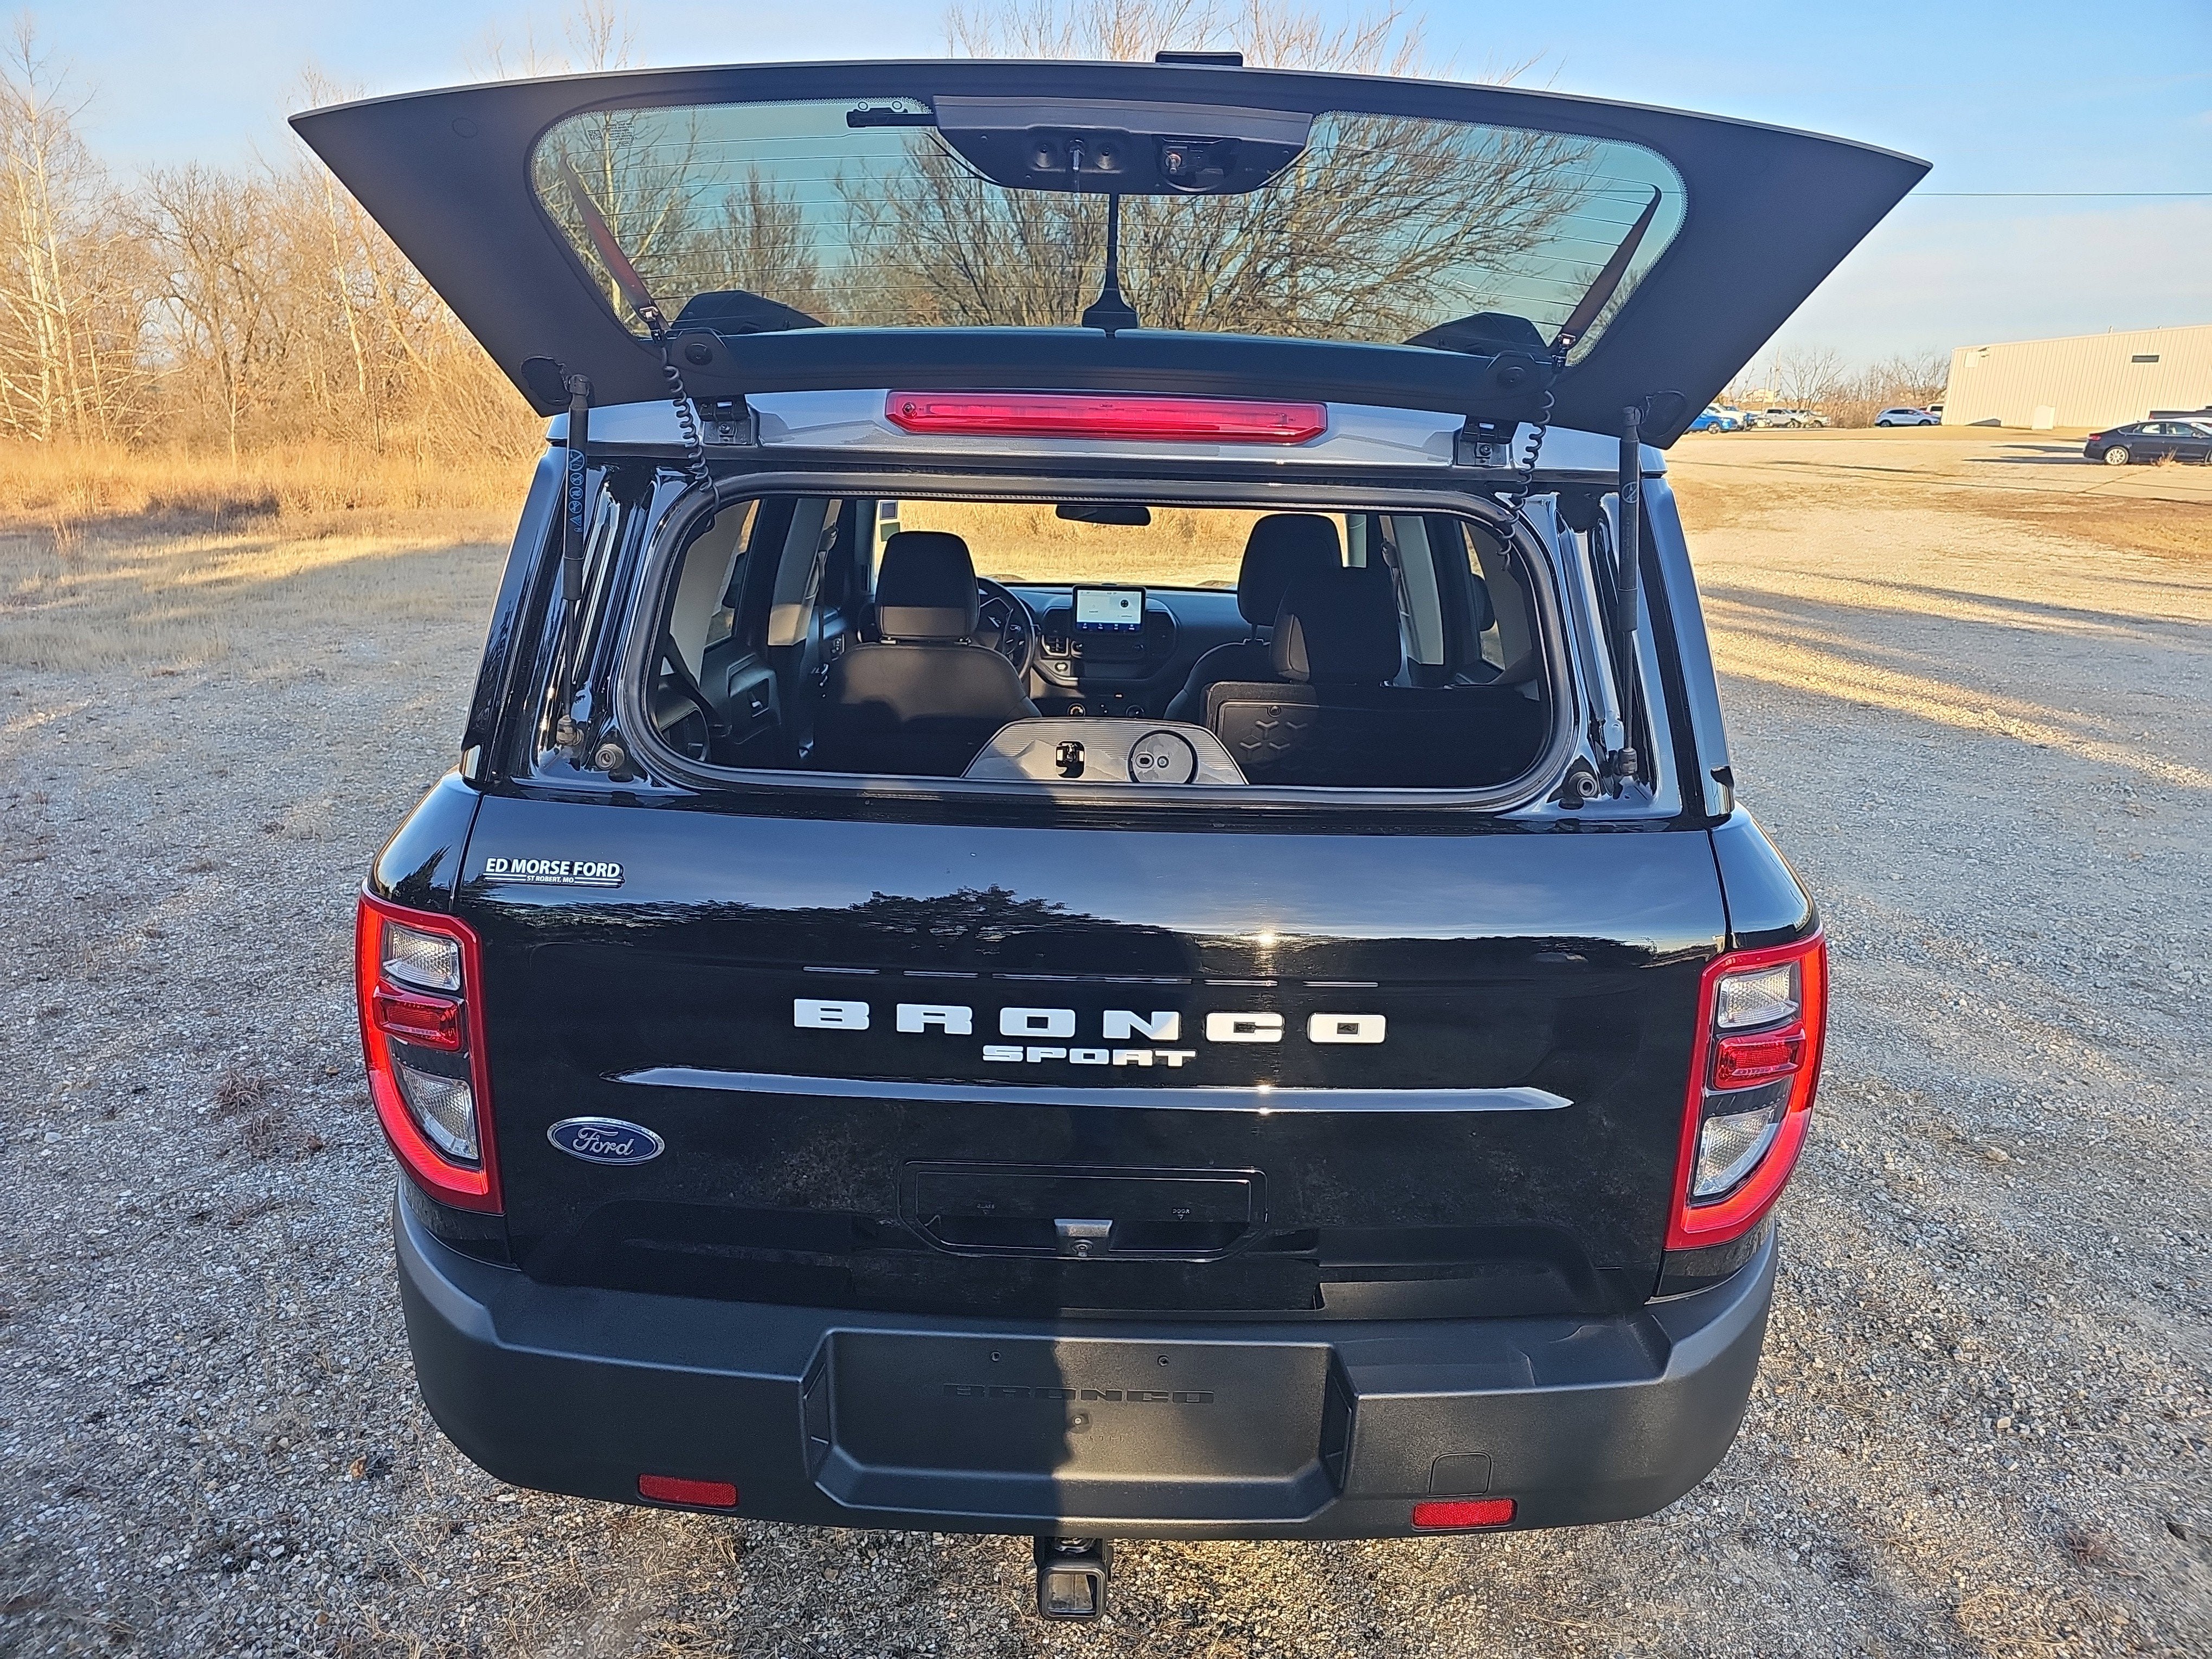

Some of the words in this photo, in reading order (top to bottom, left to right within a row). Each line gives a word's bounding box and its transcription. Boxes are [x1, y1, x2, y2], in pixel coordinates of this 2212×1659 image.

[485, 858, 507, 873] ED
[511, 859, 571, 876] MORSE
[573, 861, 621, 878] FORD
[793, 998, 1387, 1044] BRONCO
[982, 1045, 1197, 1067] SPORT
[572, 1127, 635, 1156] Ford
[943, 1382, 1214, 1403] BRONCO
